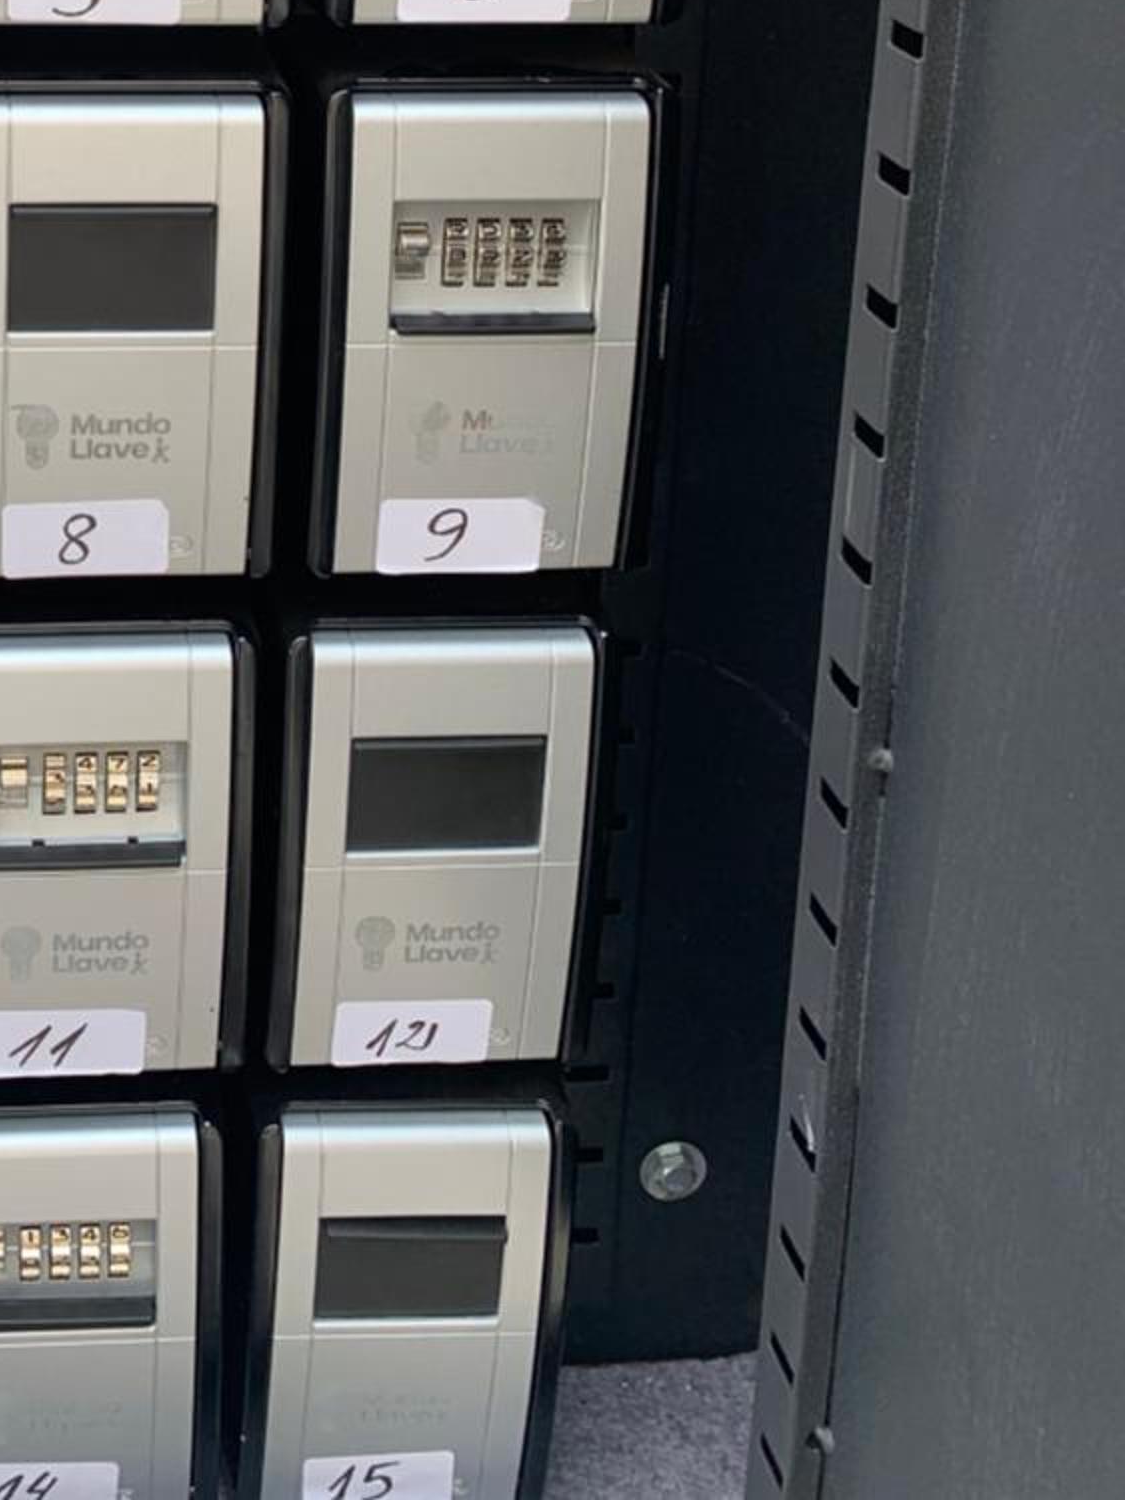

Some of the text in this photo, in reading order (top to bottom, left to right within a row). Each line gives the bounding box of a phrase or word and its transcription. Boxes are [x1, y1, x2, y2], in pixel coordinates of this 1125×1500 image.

[70, 412, 172, 436] Mundo
[69, 438, 150, 460] Llave
[58, 512, 97, 566] 8
[424, 507, 469, 562] 9
[51, 931, 150, 952] Mundo
[405, 921, 501, 942] Mundo
[51, 954, 126, 975] Llave
[404, 945, 481, 965] Llave
[8, 1021, 89, 1068] 11
